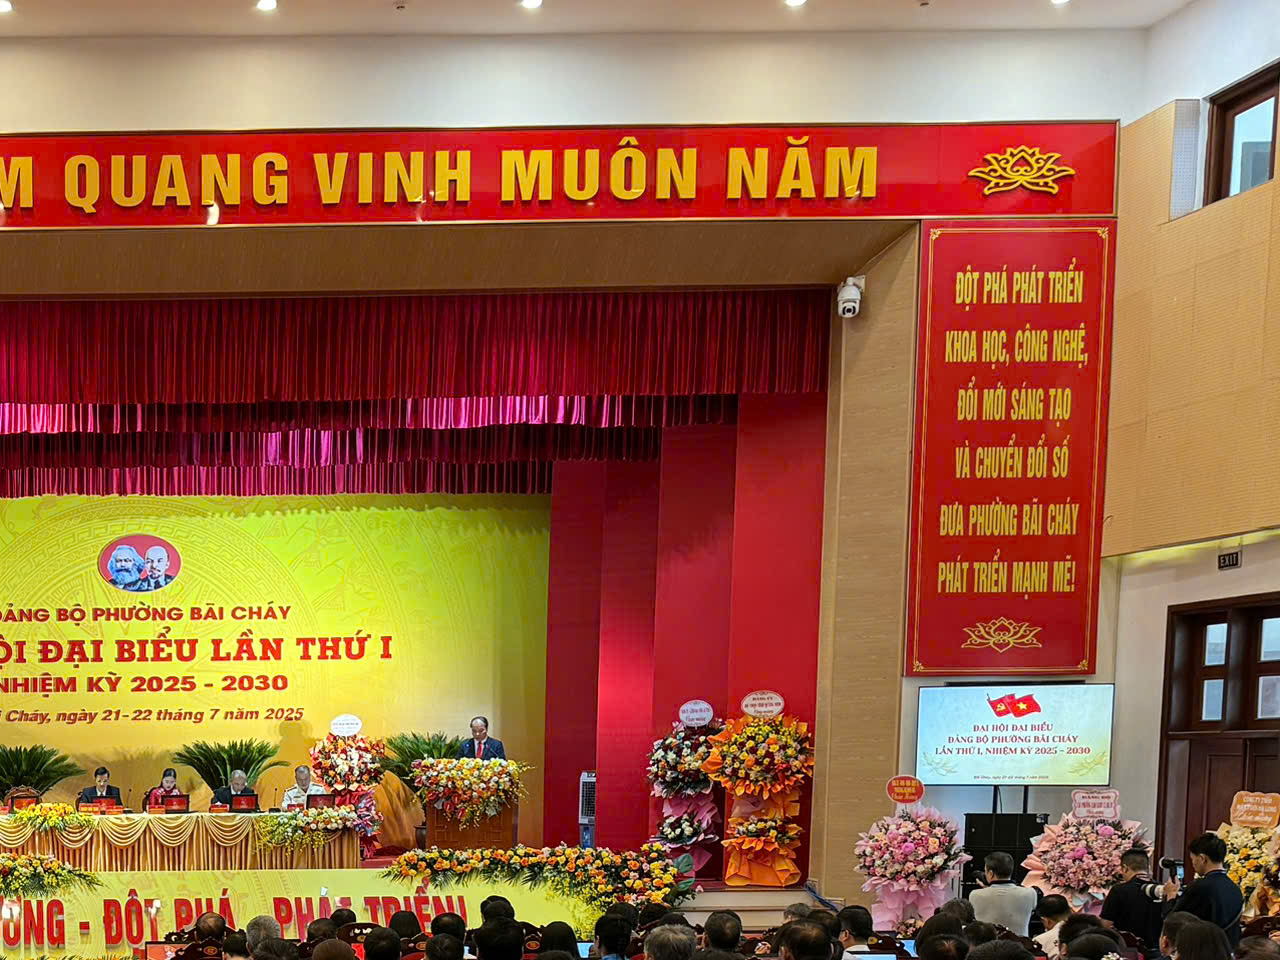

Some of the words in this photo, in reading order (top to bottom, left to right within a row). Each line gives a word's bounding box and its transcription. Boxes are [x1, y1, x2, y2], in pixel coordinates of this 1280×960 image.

[64, 151, 290, 208] QUANG
[313, 149, 472, 204] VINH
[500, 136, 698, 202] MUÔN
[727, 137, 878, 199] NĂM
[955, 264, 979, 311] ĐỘT
[983, 264, 1008, 304] PHÁ
[1012, 264, 1044, 304] PHÁT
[1048, 257, 1083, 304] TRIỂN
[945, 330, 977, 363] KHOA
[982, 330, 1010, 370] HỌC,
[1014, 322, 1048, 363] CÔNG
[1052, 322, 1088, 369] NGHỆ,
[957, 376, 978, 421] ĐỔI
[982, 382, 1007, 421] MỚI
[1010, 381, 1044, 421] SÁNG
[1049, 388, 1072, 427] TẠO
[955, 440, 971, 478] VÀ
[975, 433, 1023, 479] CHUYỂN
[1027, 433, 1047, 478] ĐỔI
[1052, 434, 1070, 478] SỐ
[939, 501, 964, 536] ĐƯA
[968, 496, 1018, 536] PHƯỜNG
[1022, 498, 1042, 536] BÃI
[1047, 497, 1080, 535] CHÁY
[937, 555, 969, 593] PHÁT
[973, 548, 1008, 593] TRIỂN
[1012, 561, 1049, 600] MẠNH
[1052, 555, 1076, 593] MẼ!
[1220, 553, 1237, 566] EXIT
[55, 602, 87, 627] BỘ
[92, 601, 184, 622] PHƯỜNG
[189, 602, 224, 622] BÃI
[230, 600, 292, 621] CHÁY
[37, 640, 105, 669] ĐẠI
[114, 626, 198, 662] BIỂU
[211, 626, 284, 661] LẦN
[295, 633, 373, 660] THỨ
[378, 635, 393, 659] I
[86, 672, 123, 693] KỲ
[129, 675, 197, 693] 2025
[223, 674, 288, 692] 2030
[6, 709, 51, 724] Cháy,
[56, 708, 97, 724] ngày
[101, 709, 153, 721] 21-22
[156, 708, 204, 724] tháng
[209, 708, 218, 720] 7
[223, 708, 259, 720] năm
[263, 707, 304, 721] 2025
